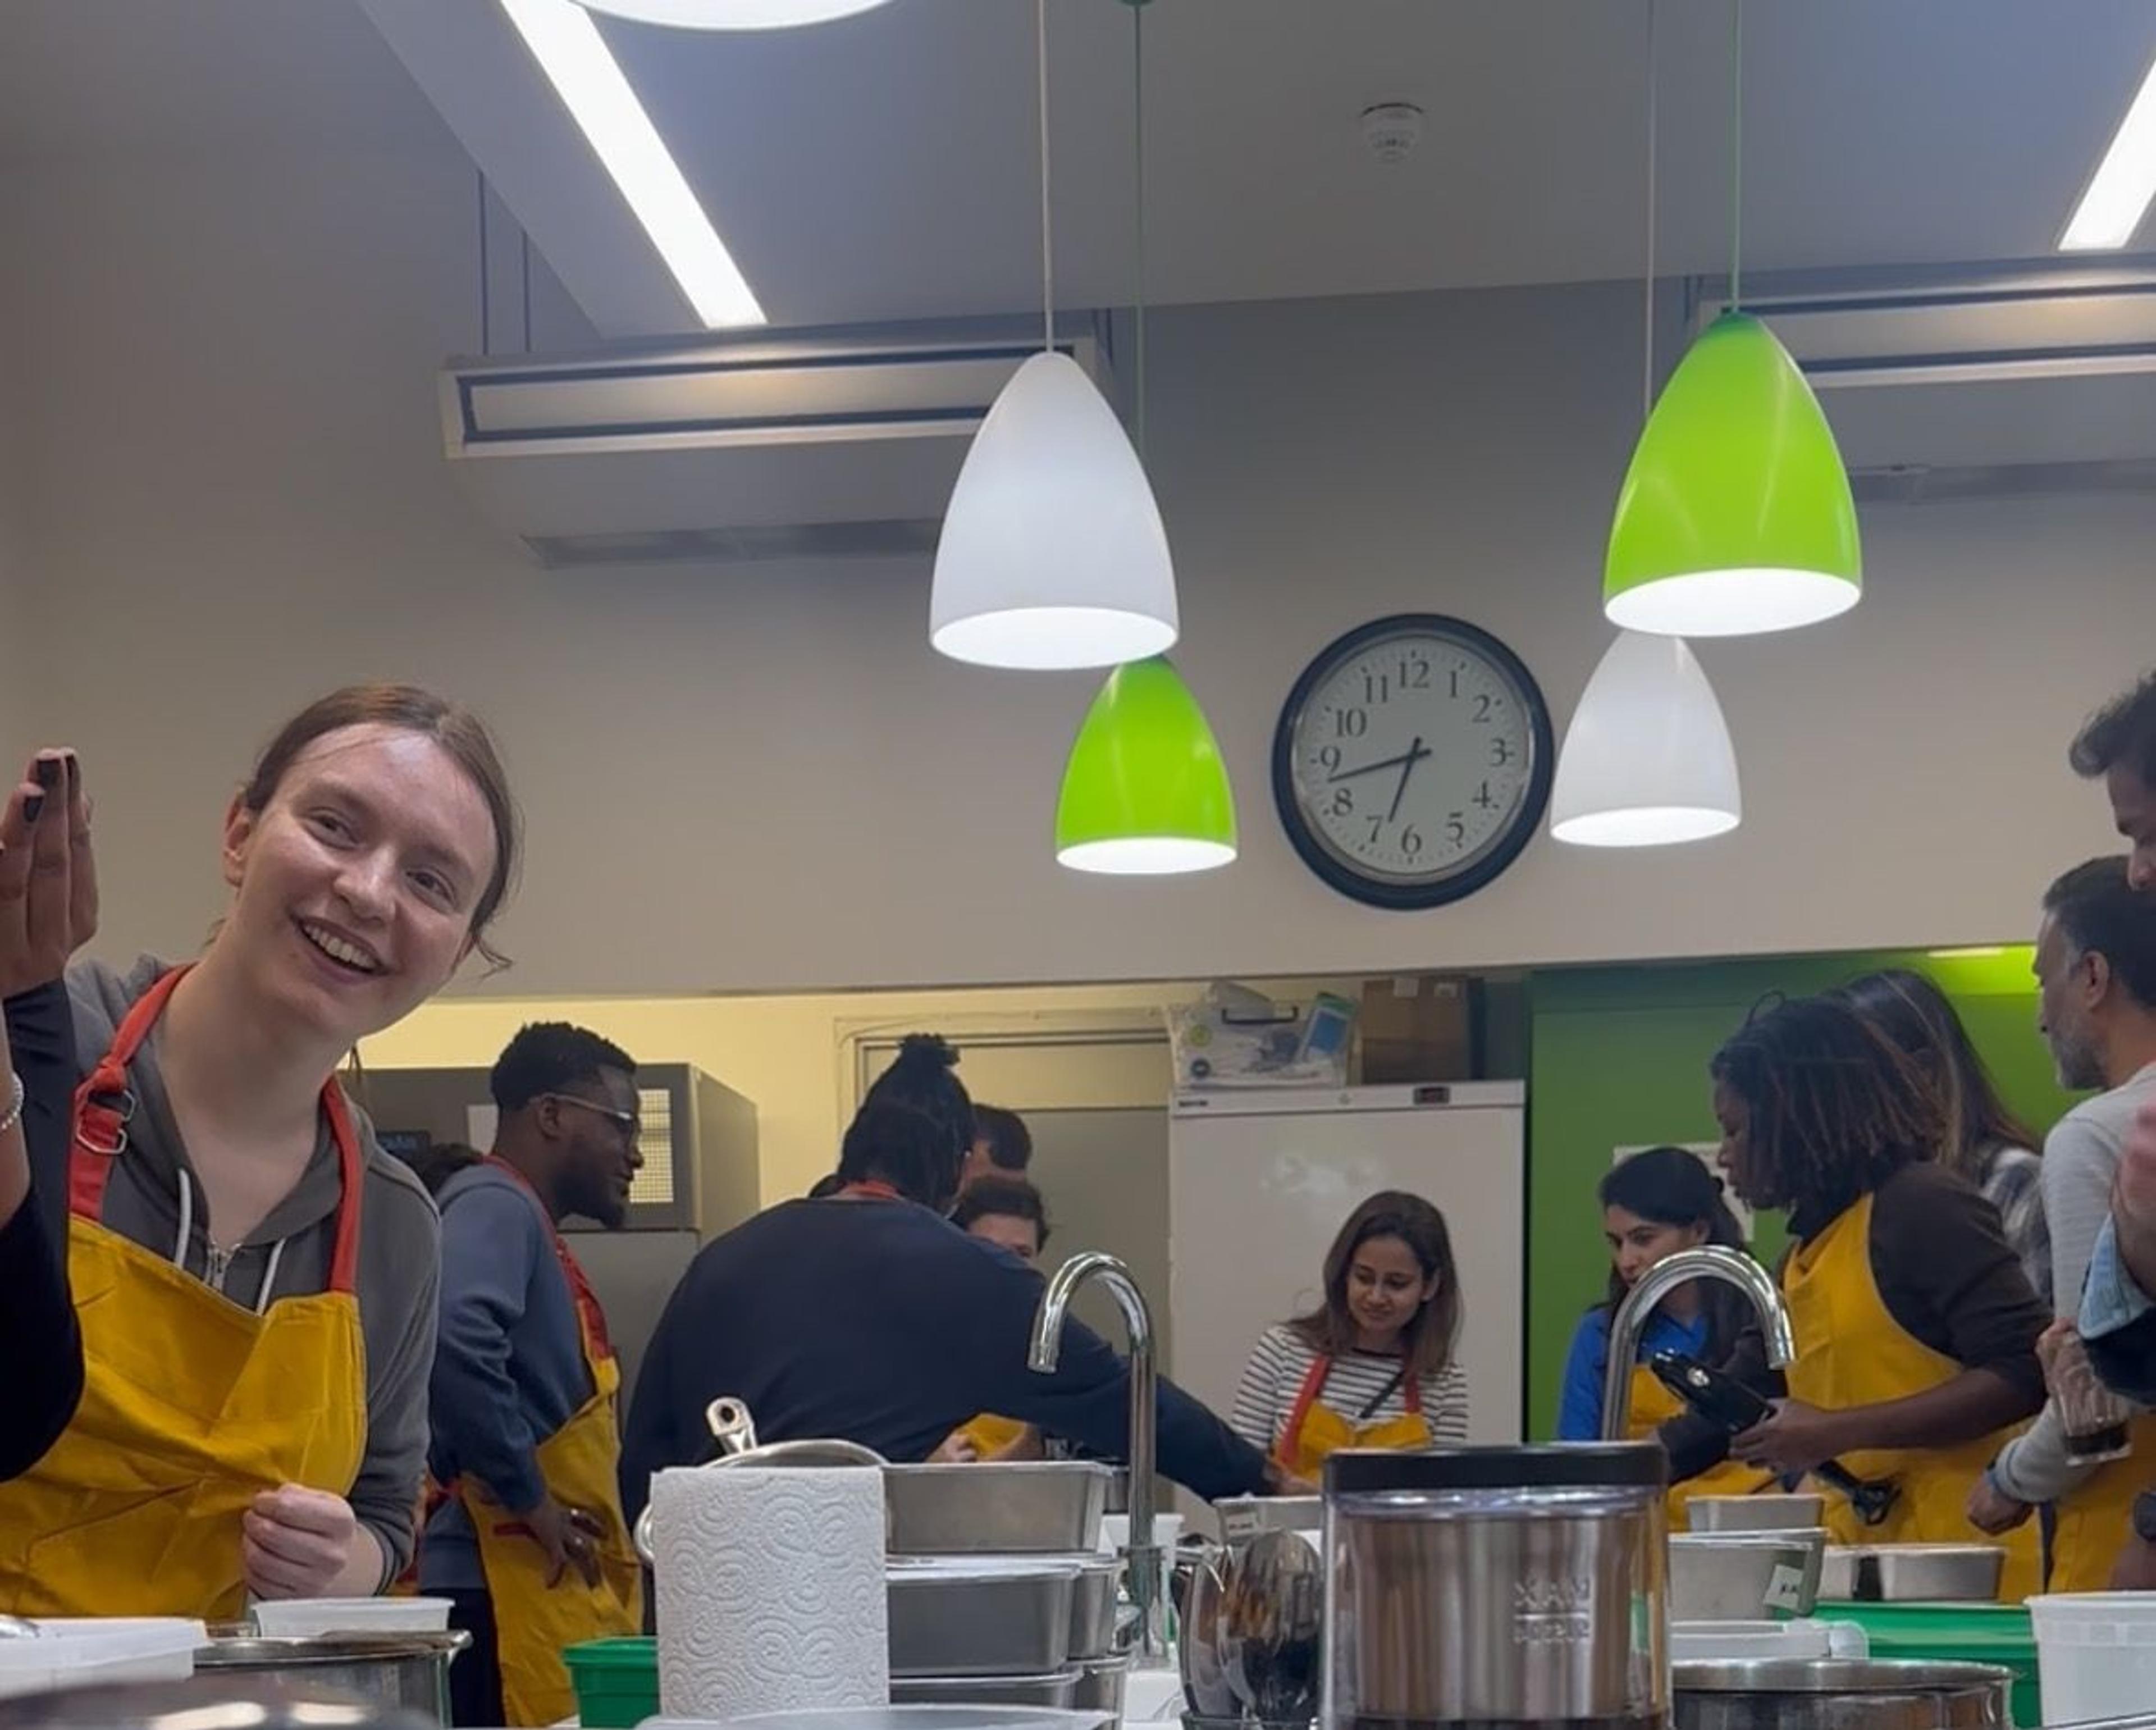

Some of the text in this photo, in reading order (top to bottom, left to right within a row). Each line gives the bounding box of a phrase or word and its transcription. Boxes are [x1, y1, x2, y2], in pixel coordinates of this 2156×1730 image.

[1399, 660, 1430, 688] 12
[1450, 670, 1458, 699] 1
[1365, 674, 1388, 703] 11
[1336, 709, 1368, 737] 10
[1472, 695, 1491, 723] 2
[1319, 746, 1342, 774] 9
[1491, 738, 1507, 766] 3
[1332, 788, 1353, 816] 8
[1472, 779, 1491, 809] 4
[1366, 815, 1384, 843] 7
[1401, 824, 1422, 855] 6
[1447, 812, 1464, 842] 5
